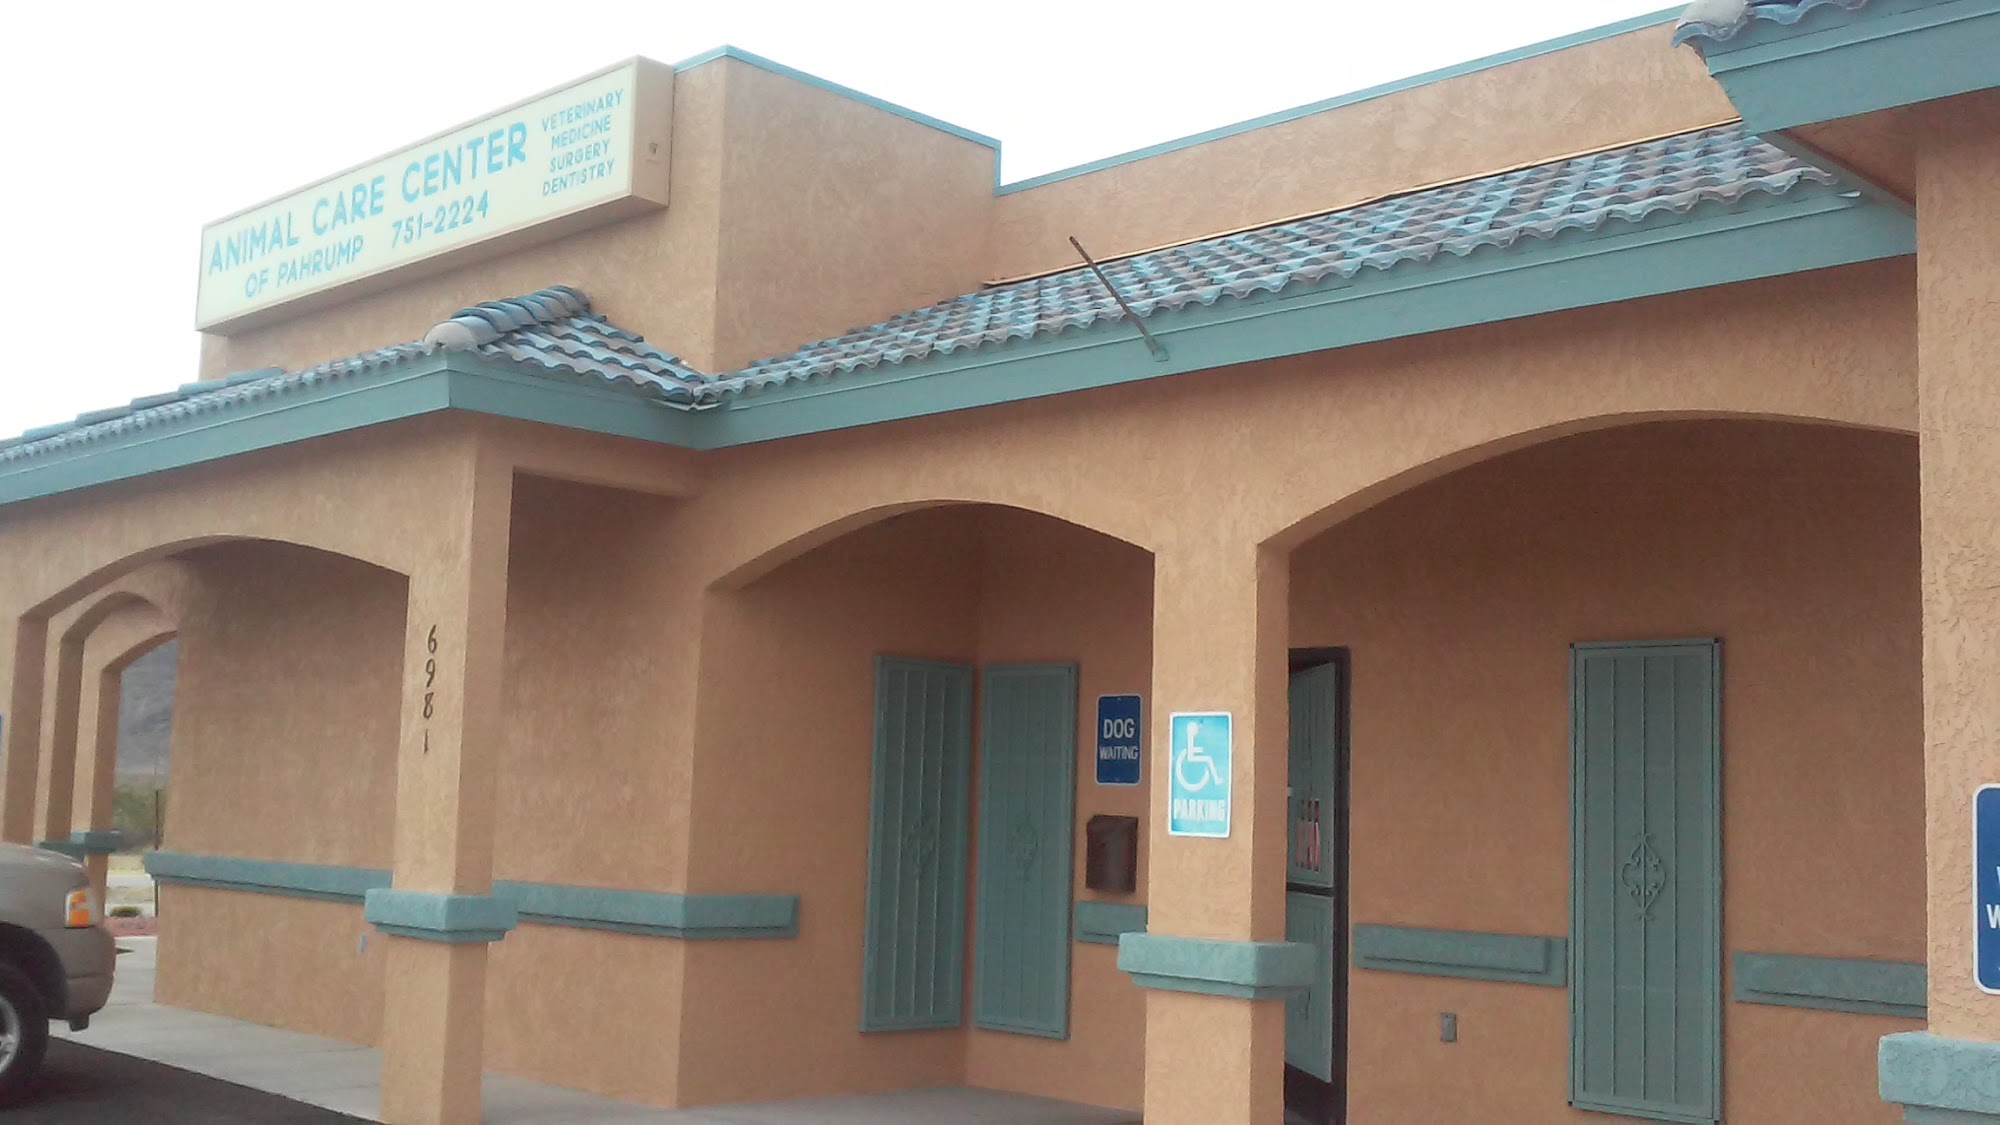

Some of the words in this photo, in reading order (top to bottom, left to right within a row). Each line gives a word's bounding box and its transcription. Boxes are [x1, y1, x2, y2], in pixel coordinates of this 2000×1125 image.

[541, 88, 624, 132] VETERINARY
[551, 115, 612, 150] MEDICINE
[550, 138, 612, 173] SURGERY
[542, 158, 615, 197] DENTISTRY
[209, 210, 299, 276] ANIMAL
[312, 175, 386, 236] CARE
[401, 122, 528, 203] CENTER
[391, 190, 489, 248] 751-2224
[245, 268, 270, 298] OF
[277, 235, 364, 288] PAHRUMP
[423, 624, 437, 754] 6981
[1103, 718, 1135, 739] DOG
[1100, 746, 1139, 760] WAITING
[1173, 799, 1226, 822] PARKING
